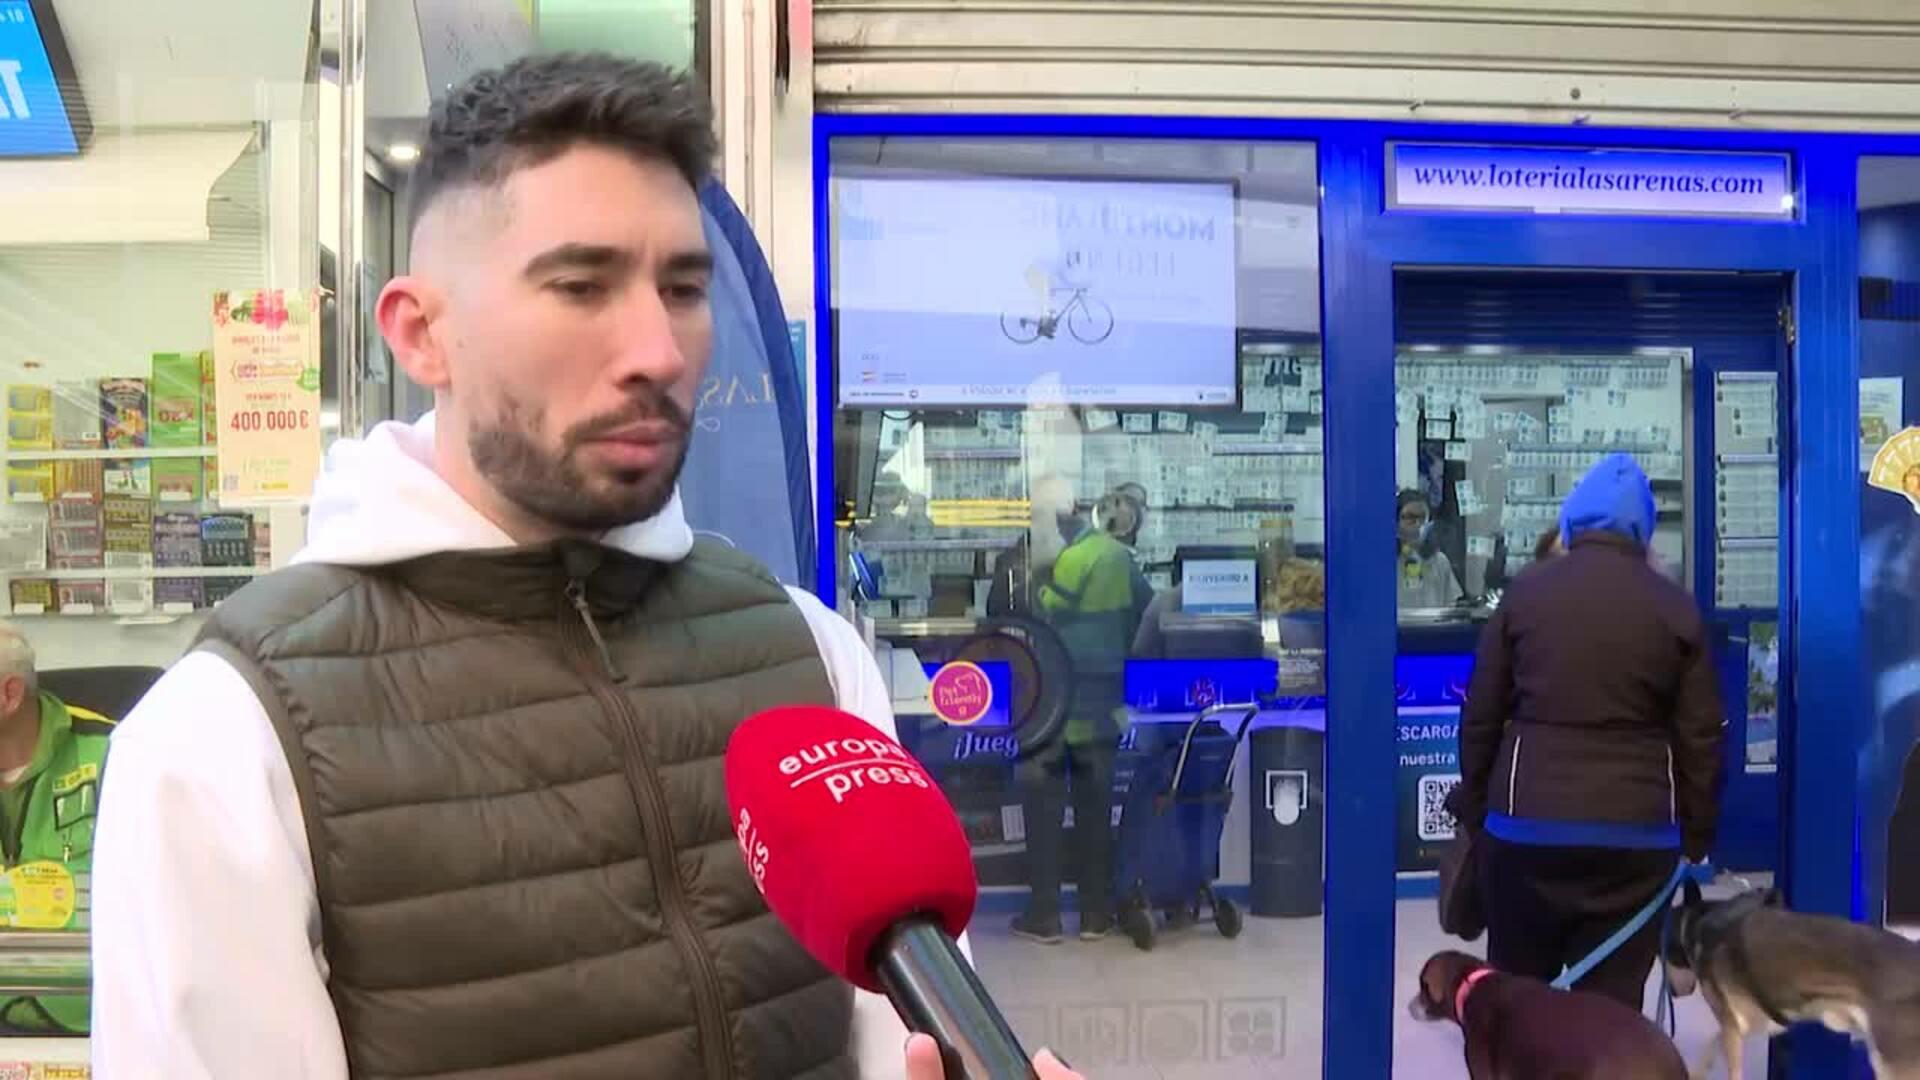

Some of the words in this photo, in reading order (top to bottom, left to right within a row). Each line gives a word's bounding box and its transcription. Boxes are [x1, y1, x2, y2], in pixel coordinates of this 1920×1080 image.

[1413, 163, 1764, 194] www.loterialasarenas.com
[231, 411, 262, 431] 400
[1399, 751, 1456, 766] nuestra
[824, 766, 929, 804] press
